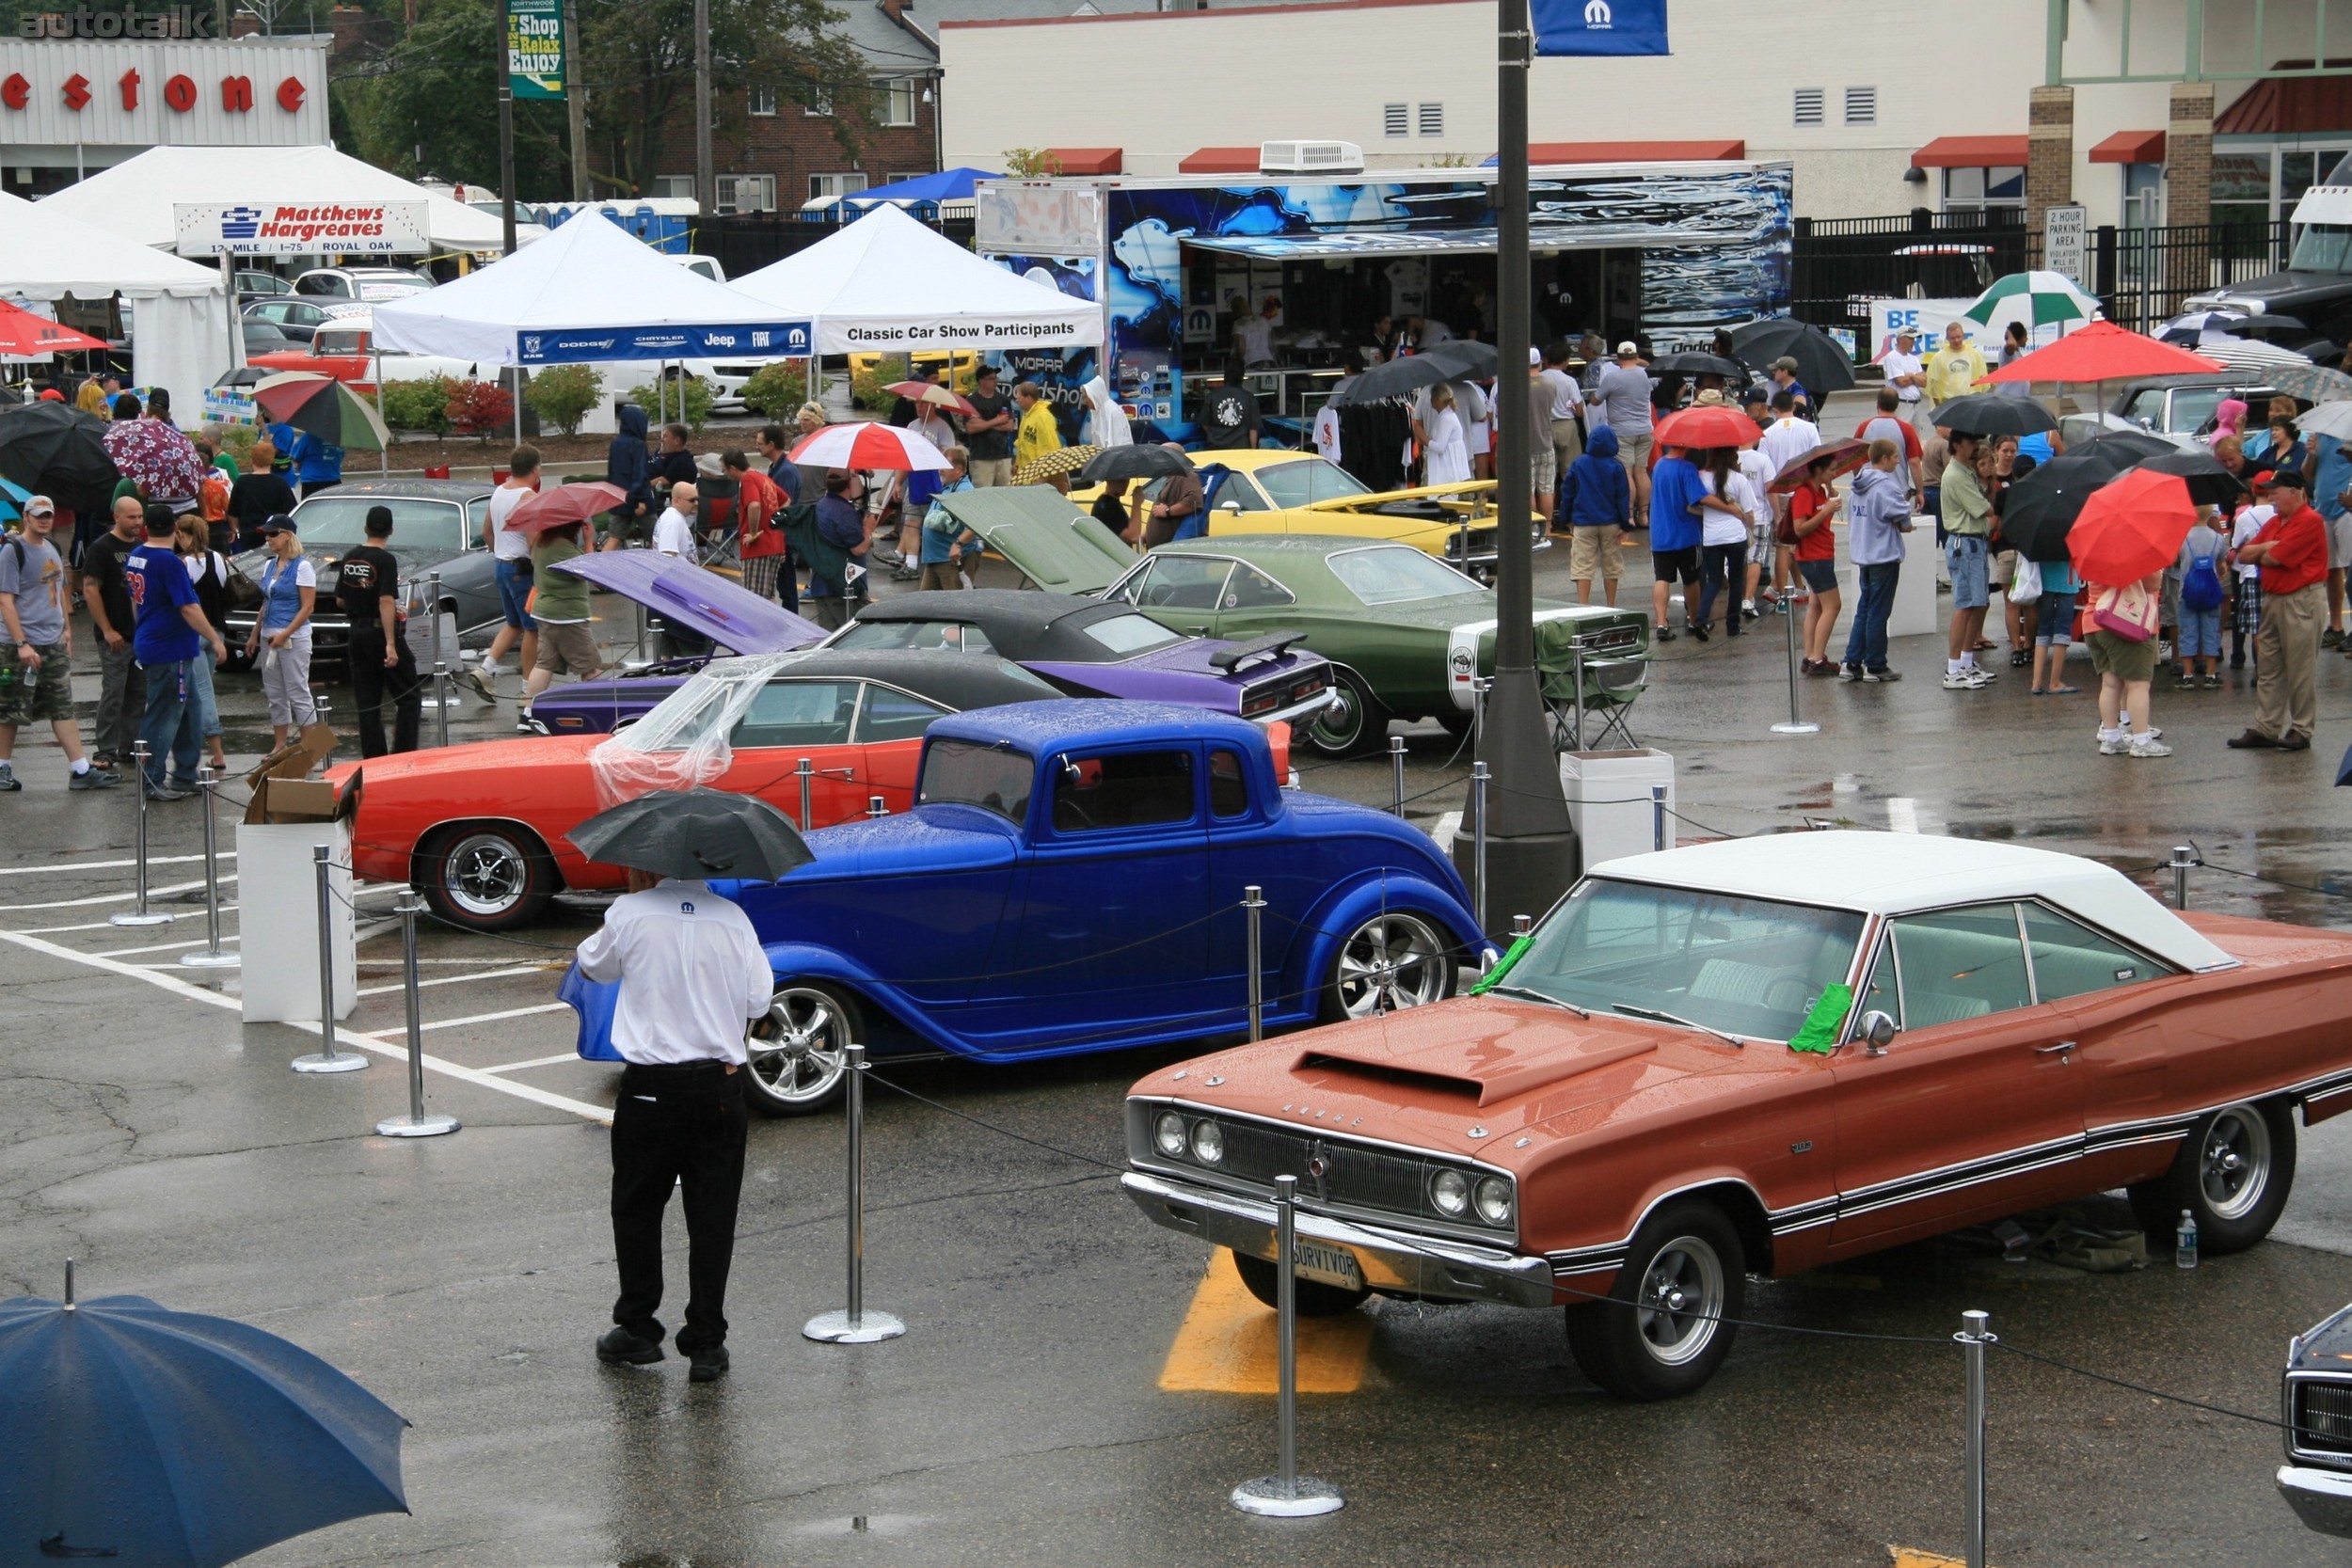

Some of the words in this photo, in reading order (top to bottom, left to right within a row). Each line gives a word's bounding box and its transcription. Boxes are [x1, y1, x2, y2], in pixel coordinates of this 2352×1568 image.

[508, 14, 519, 48] DINE
[519, 14, 559, 40] Shop
[519, 35, 560, 54] Relax
[508, 49, 561, 72] Enjoy
[274, 207, 384, 222] Matthews
[2051, 213, 2057, 222] 2
[2059, 212, 2081, 222] HOUR
[260, 222, 384, 242] Hargreaves
[2049, 223, 2081, 234] PARKING
[211, 245, 225, 253] 12
[232, 244, 261, 252] MILE
[280, 243, 303, 251] I-75
[323, 242, 360, 251] ROYAL
[369, 242, 393, 250] OAK
[2055, 236, 2075, 246] AREA
[2049, 249, 2080, 258] VIOLATORS
[1887, 310, 1919, 328] BE
[704, 333, 736, 347] Jeep
[753, 331, 770, 347] FIAT
[847, 326, 903, 341] Classic
[908, 326, 934, 339] Car
[939, 325, 979, 338] Show
[984, 323, 1074, 338] Participants
[34, 337, 83, 345] DODGE
[1015, 356, 1064, 373] MOPAR
[1294, 1243, 1356, 1277] SURVIVOR
